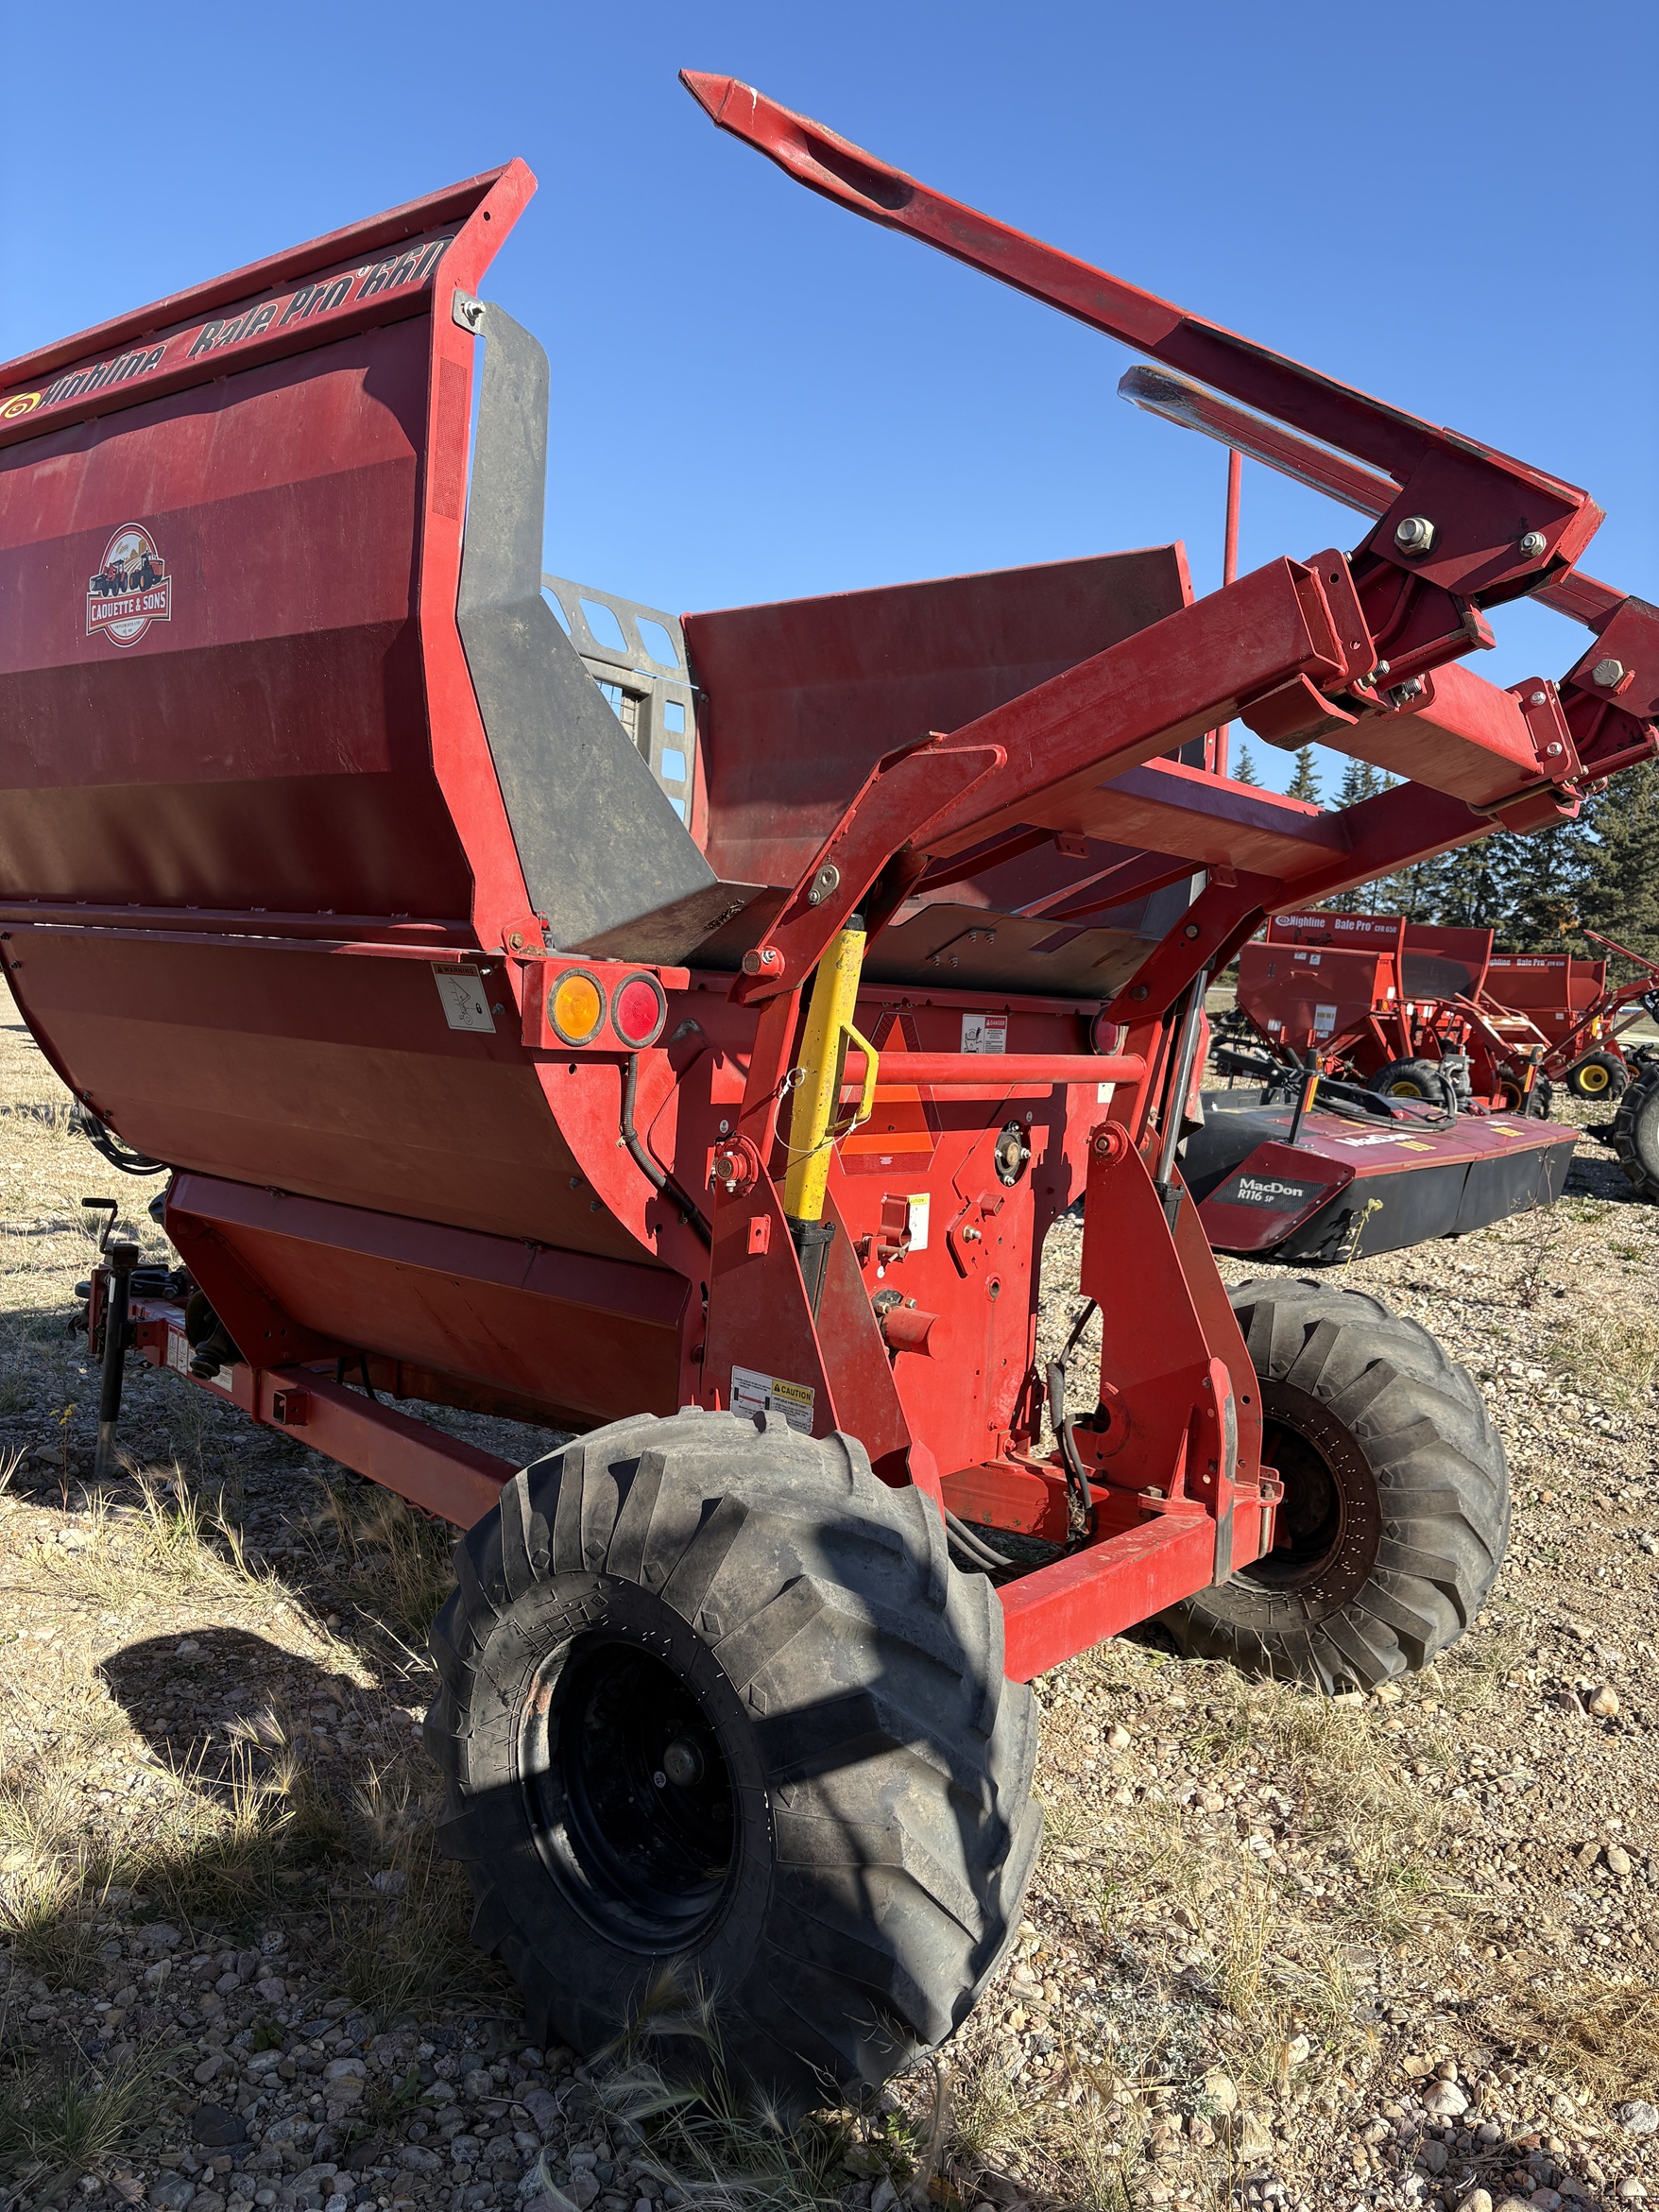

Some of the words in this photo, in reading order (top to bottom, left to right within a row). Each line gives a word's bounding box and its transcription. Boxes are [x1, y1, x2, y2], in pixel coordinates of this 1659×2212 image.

[91, 599, 134, 621] CAOUETTE
[135, 598, 141, 610] &
[143, 591, 166, 609] SONS
[1291, 916, 1325, 928] Highline
[1334, 918, 1355, 930] Bale
[443, 967, 474, 975] WARNING
[1240, 1177, 1304, 1197] MacDon
[1237, 1189, 1263, 1201] R116
[1264, 1194, 1274, 1203] SP
[781, 1385, 811, 1400] CAUTION
